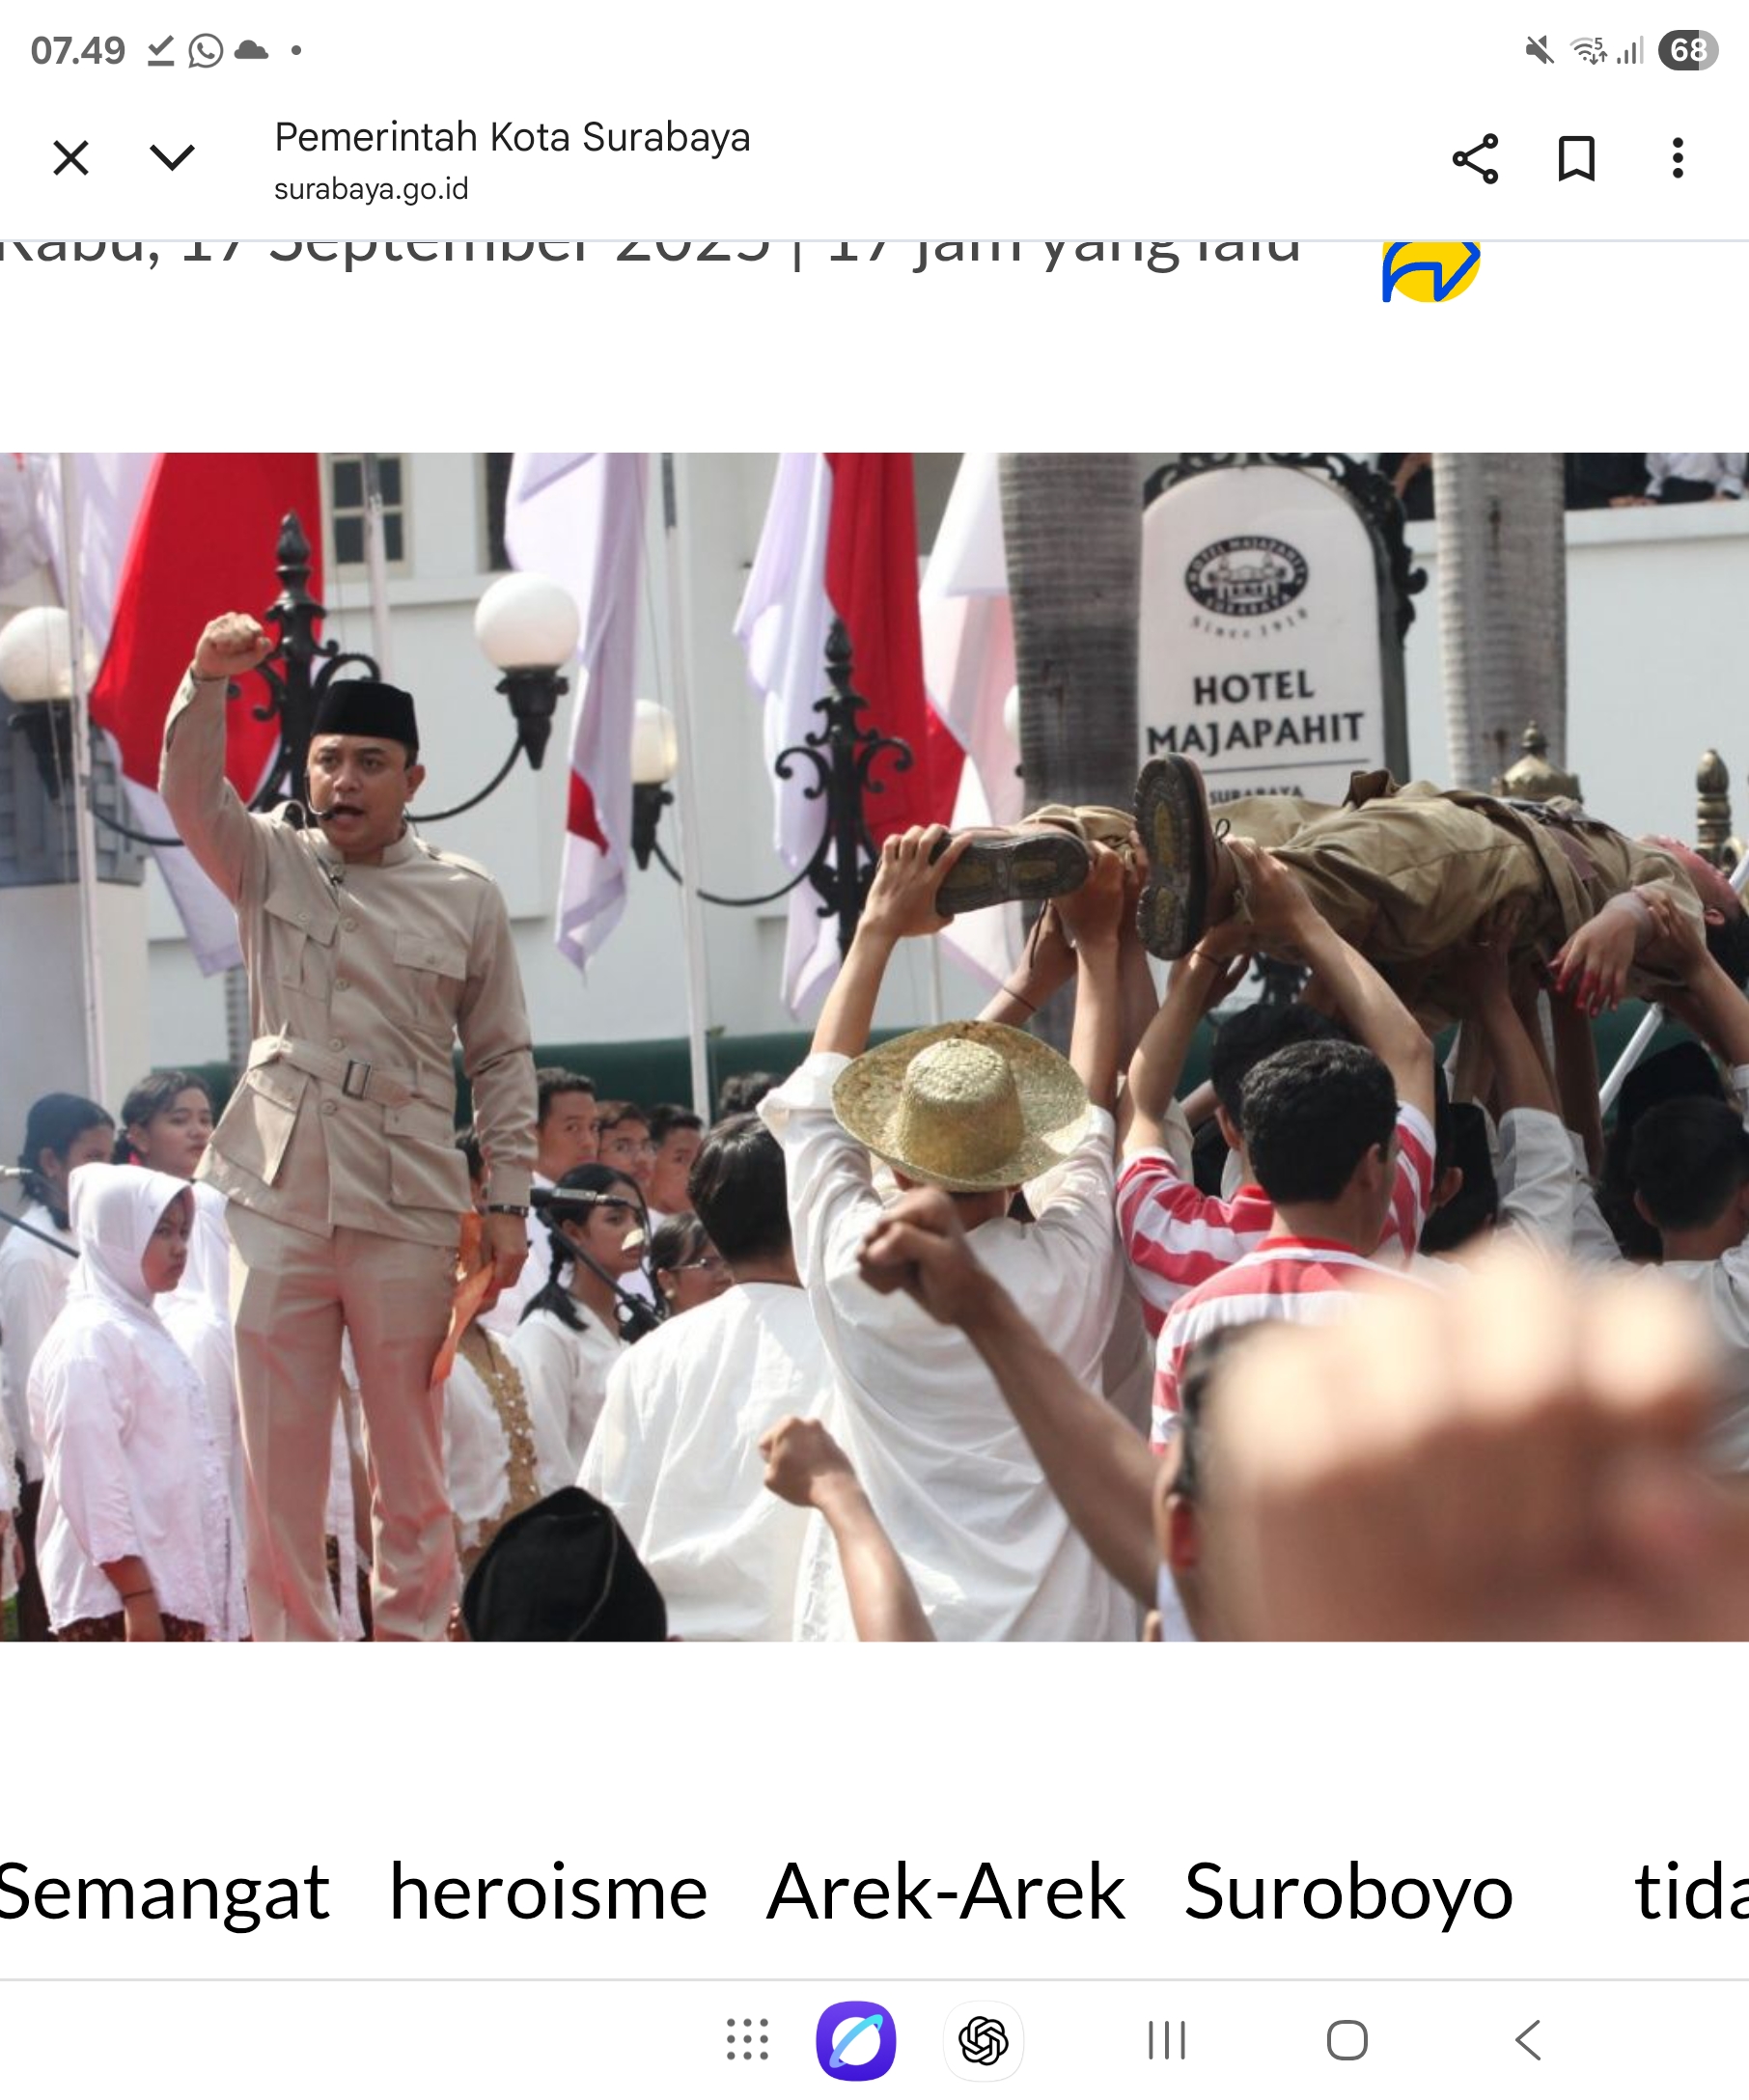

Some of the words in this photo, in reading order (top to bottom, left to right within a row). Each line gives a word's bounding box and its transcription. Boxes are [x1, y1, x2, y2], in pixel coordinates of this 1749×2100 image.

[31, 36, 125, 65] 07.49
[1595, 37, 1603, 50] 5
[1671, 38, 1707, 62] 68
[276, 119, 477, 152] Pemerintah
[491, 122, 569, 152] Kota
[583, 119, 750, 160] Surabaya
[274, 175, 468, 207] surabaya.go.id
[1192, 669, 1316, 705] HOTEL
[1146, 711, 1365, 757] MAJAPAHIT
[0, 1861, 331, 1934] Semangat
[393, 1860, 708, 1920] heroisme
[764, 1860, 1126, 1920] Arek-Arek
[1185, 1860, 1513, 1934] Suroboyo
[1634, 1860, 1749, 1920] tida
